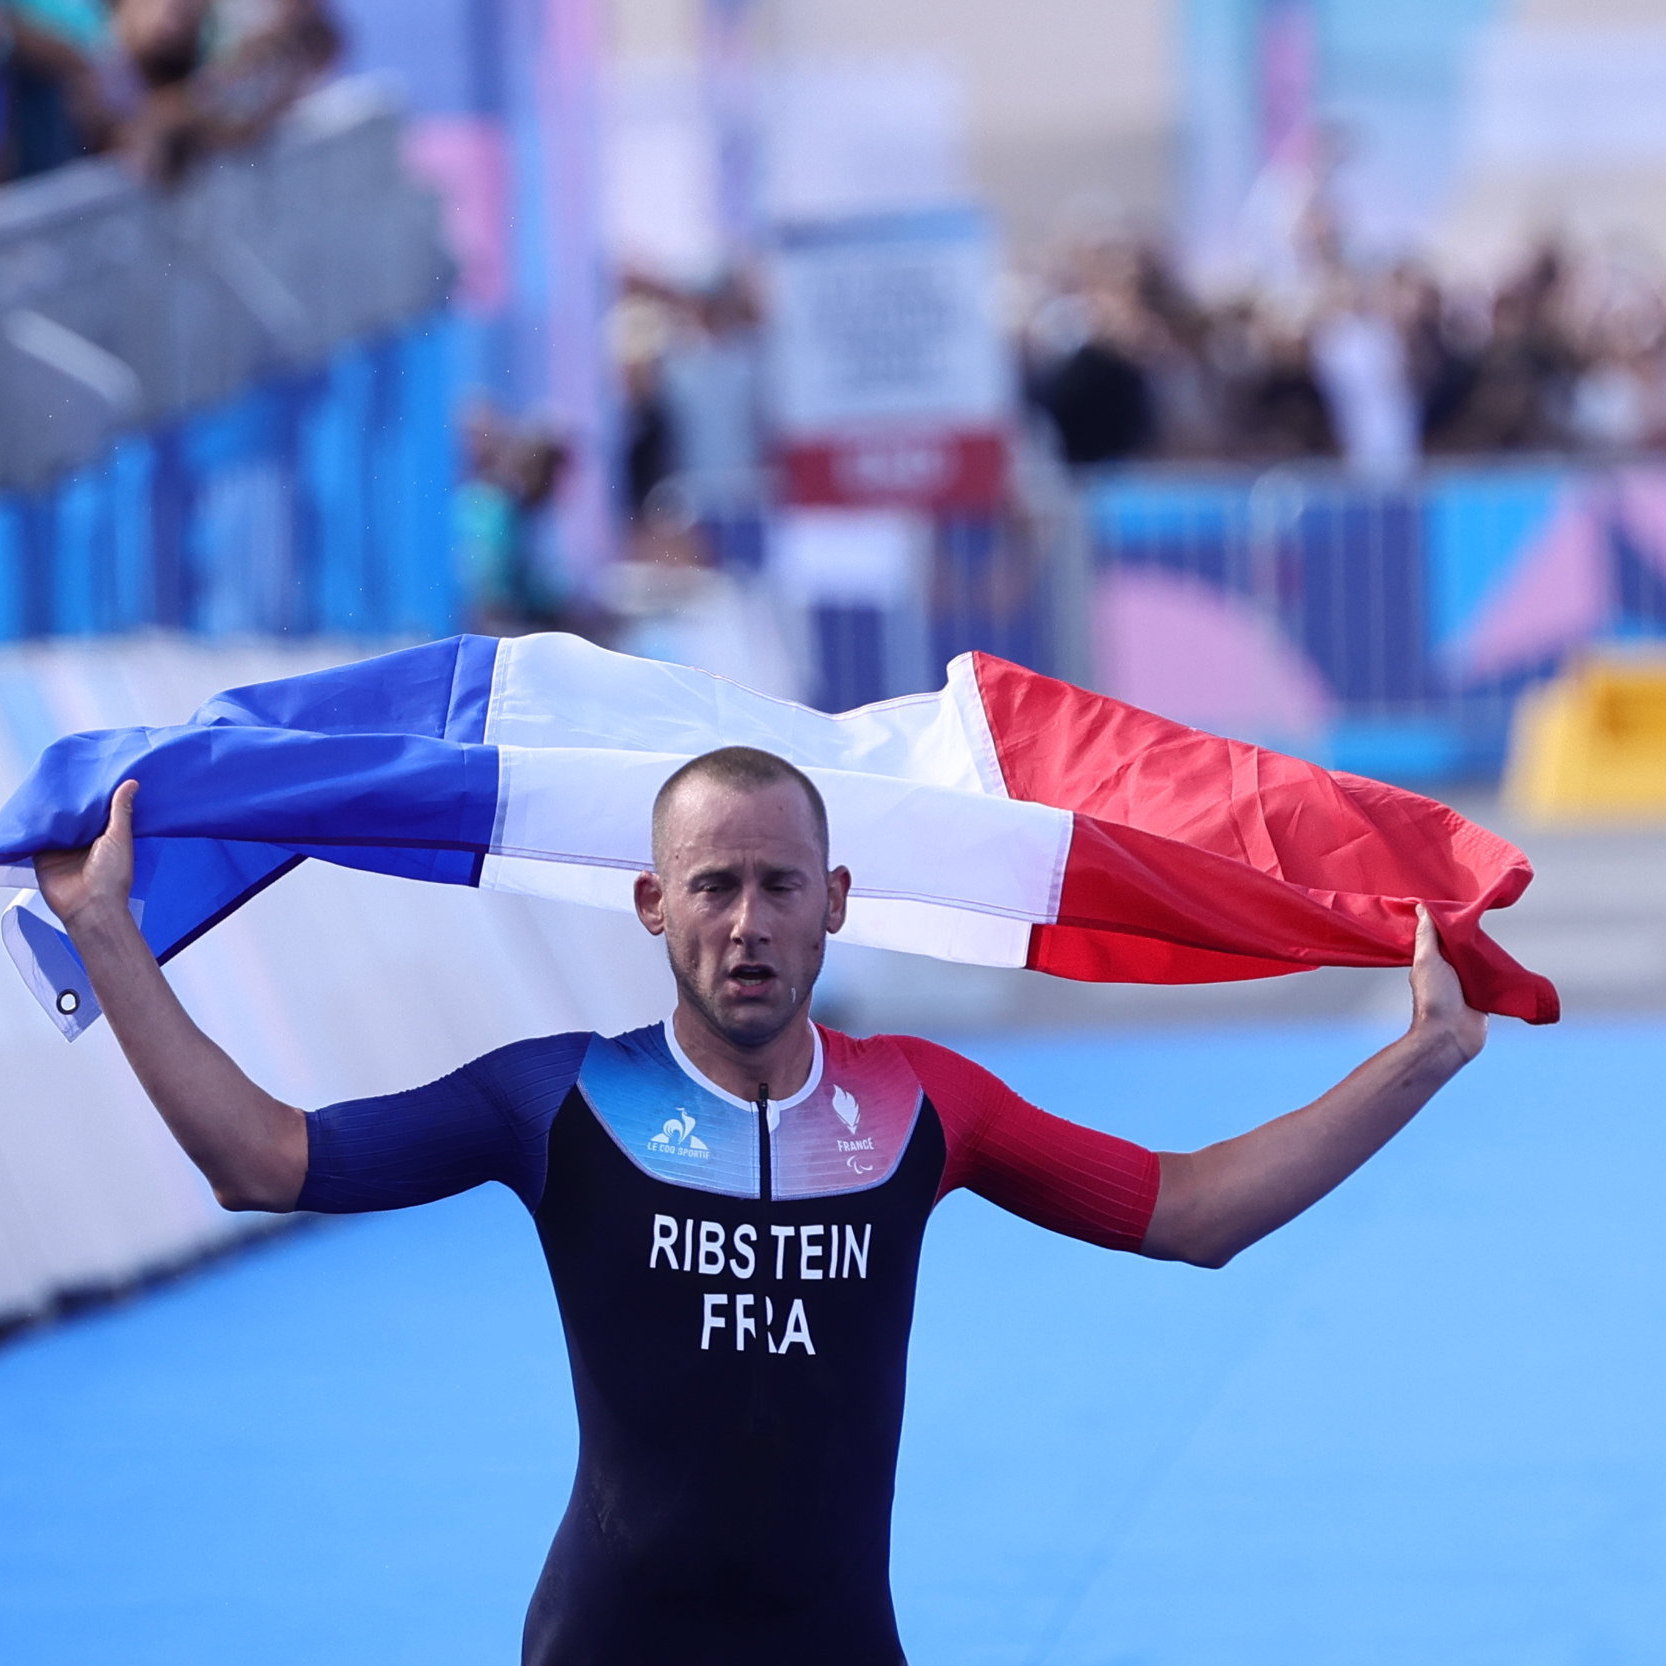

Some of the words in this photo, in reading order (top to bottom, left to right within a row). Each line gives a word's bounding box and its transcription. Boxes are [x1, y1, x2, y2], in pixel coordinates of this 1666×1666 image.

[647, 1142, 657, 1151] LE
[837, 1137, 874, 1152] FRANCE
[700, 1293, 816, 1355] FRA
